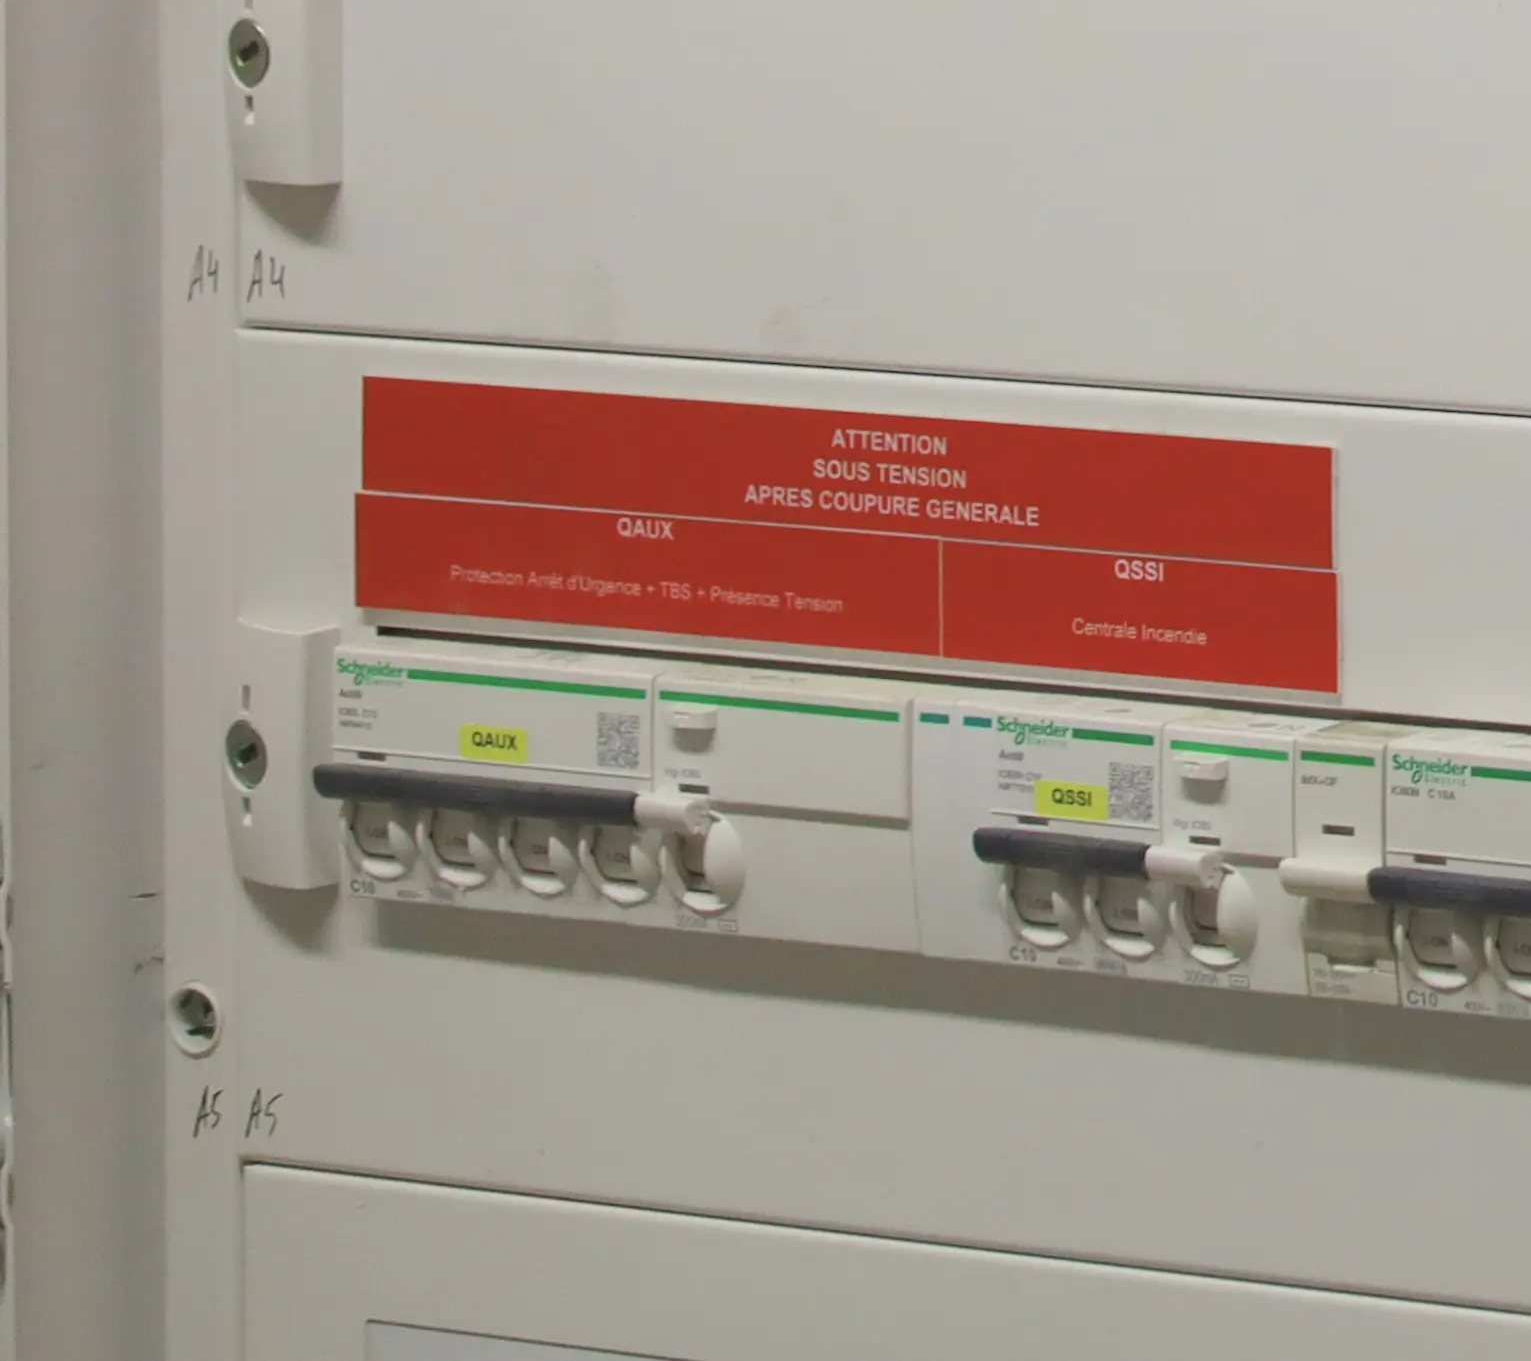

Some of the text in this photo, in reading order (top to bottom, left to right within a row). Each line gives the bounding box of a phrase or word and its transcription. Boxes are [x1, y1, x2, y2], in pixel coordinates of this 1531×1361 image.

[187, 243, 220, 303] A4
[246, 248, 286, 304] A4
[831, 428, 947, 456] ATTENTION
[810, 456, 966, 489] SOUS TENSION
[742, 482, 1040, 527] APRES COUPURE GENERALE
[615, 514, 677, 540] QAUX
[1111, 555, 1167, 584] QSSI
[450, 564, 524, 586] Protection
[658, 577, 693, 602] TBS
[784, 591, 843, 612] Tension
[1071, 617, 1208, 646] Centrale Incendie
[470, 730, 519, 752] QAUX
[997, 716, 1070, 745] Schneider
[1392, 753, 1469, 784] Schneider
[1051, 787, 1092, 808] QSSI
[1407, 988, 1438, 1008] C10
[193, 1085, 224, 1139] A5
[244, 1088, 283, 1139] A5
